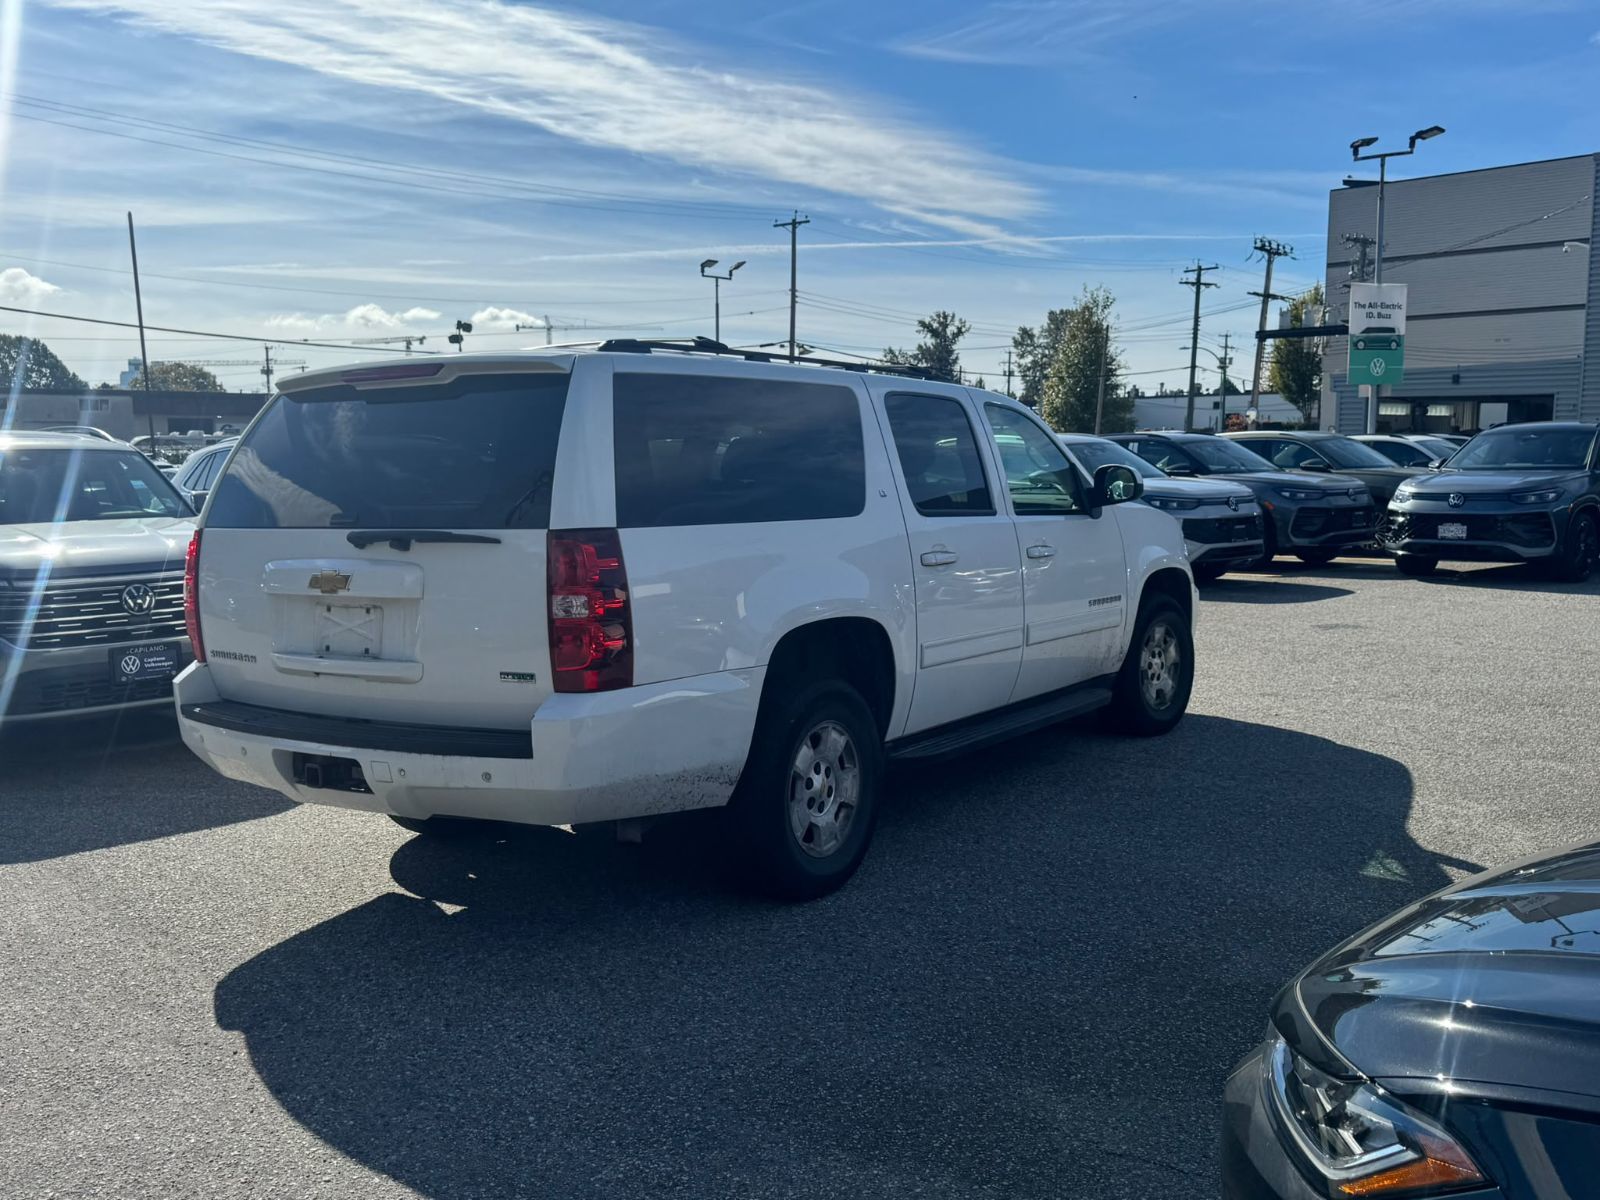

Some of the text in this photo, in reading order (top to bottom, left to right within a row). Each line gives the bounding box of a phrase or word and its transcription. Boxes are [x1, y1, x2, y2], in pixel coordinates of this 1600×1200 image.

[1354, 301, 1403, 310] The All-Electric
[1365, 311, 1392, 320] ID. Buzz
[129, 644, 165, 655] CAPILANO
[144, 661, 174, 669] Volkswagen
